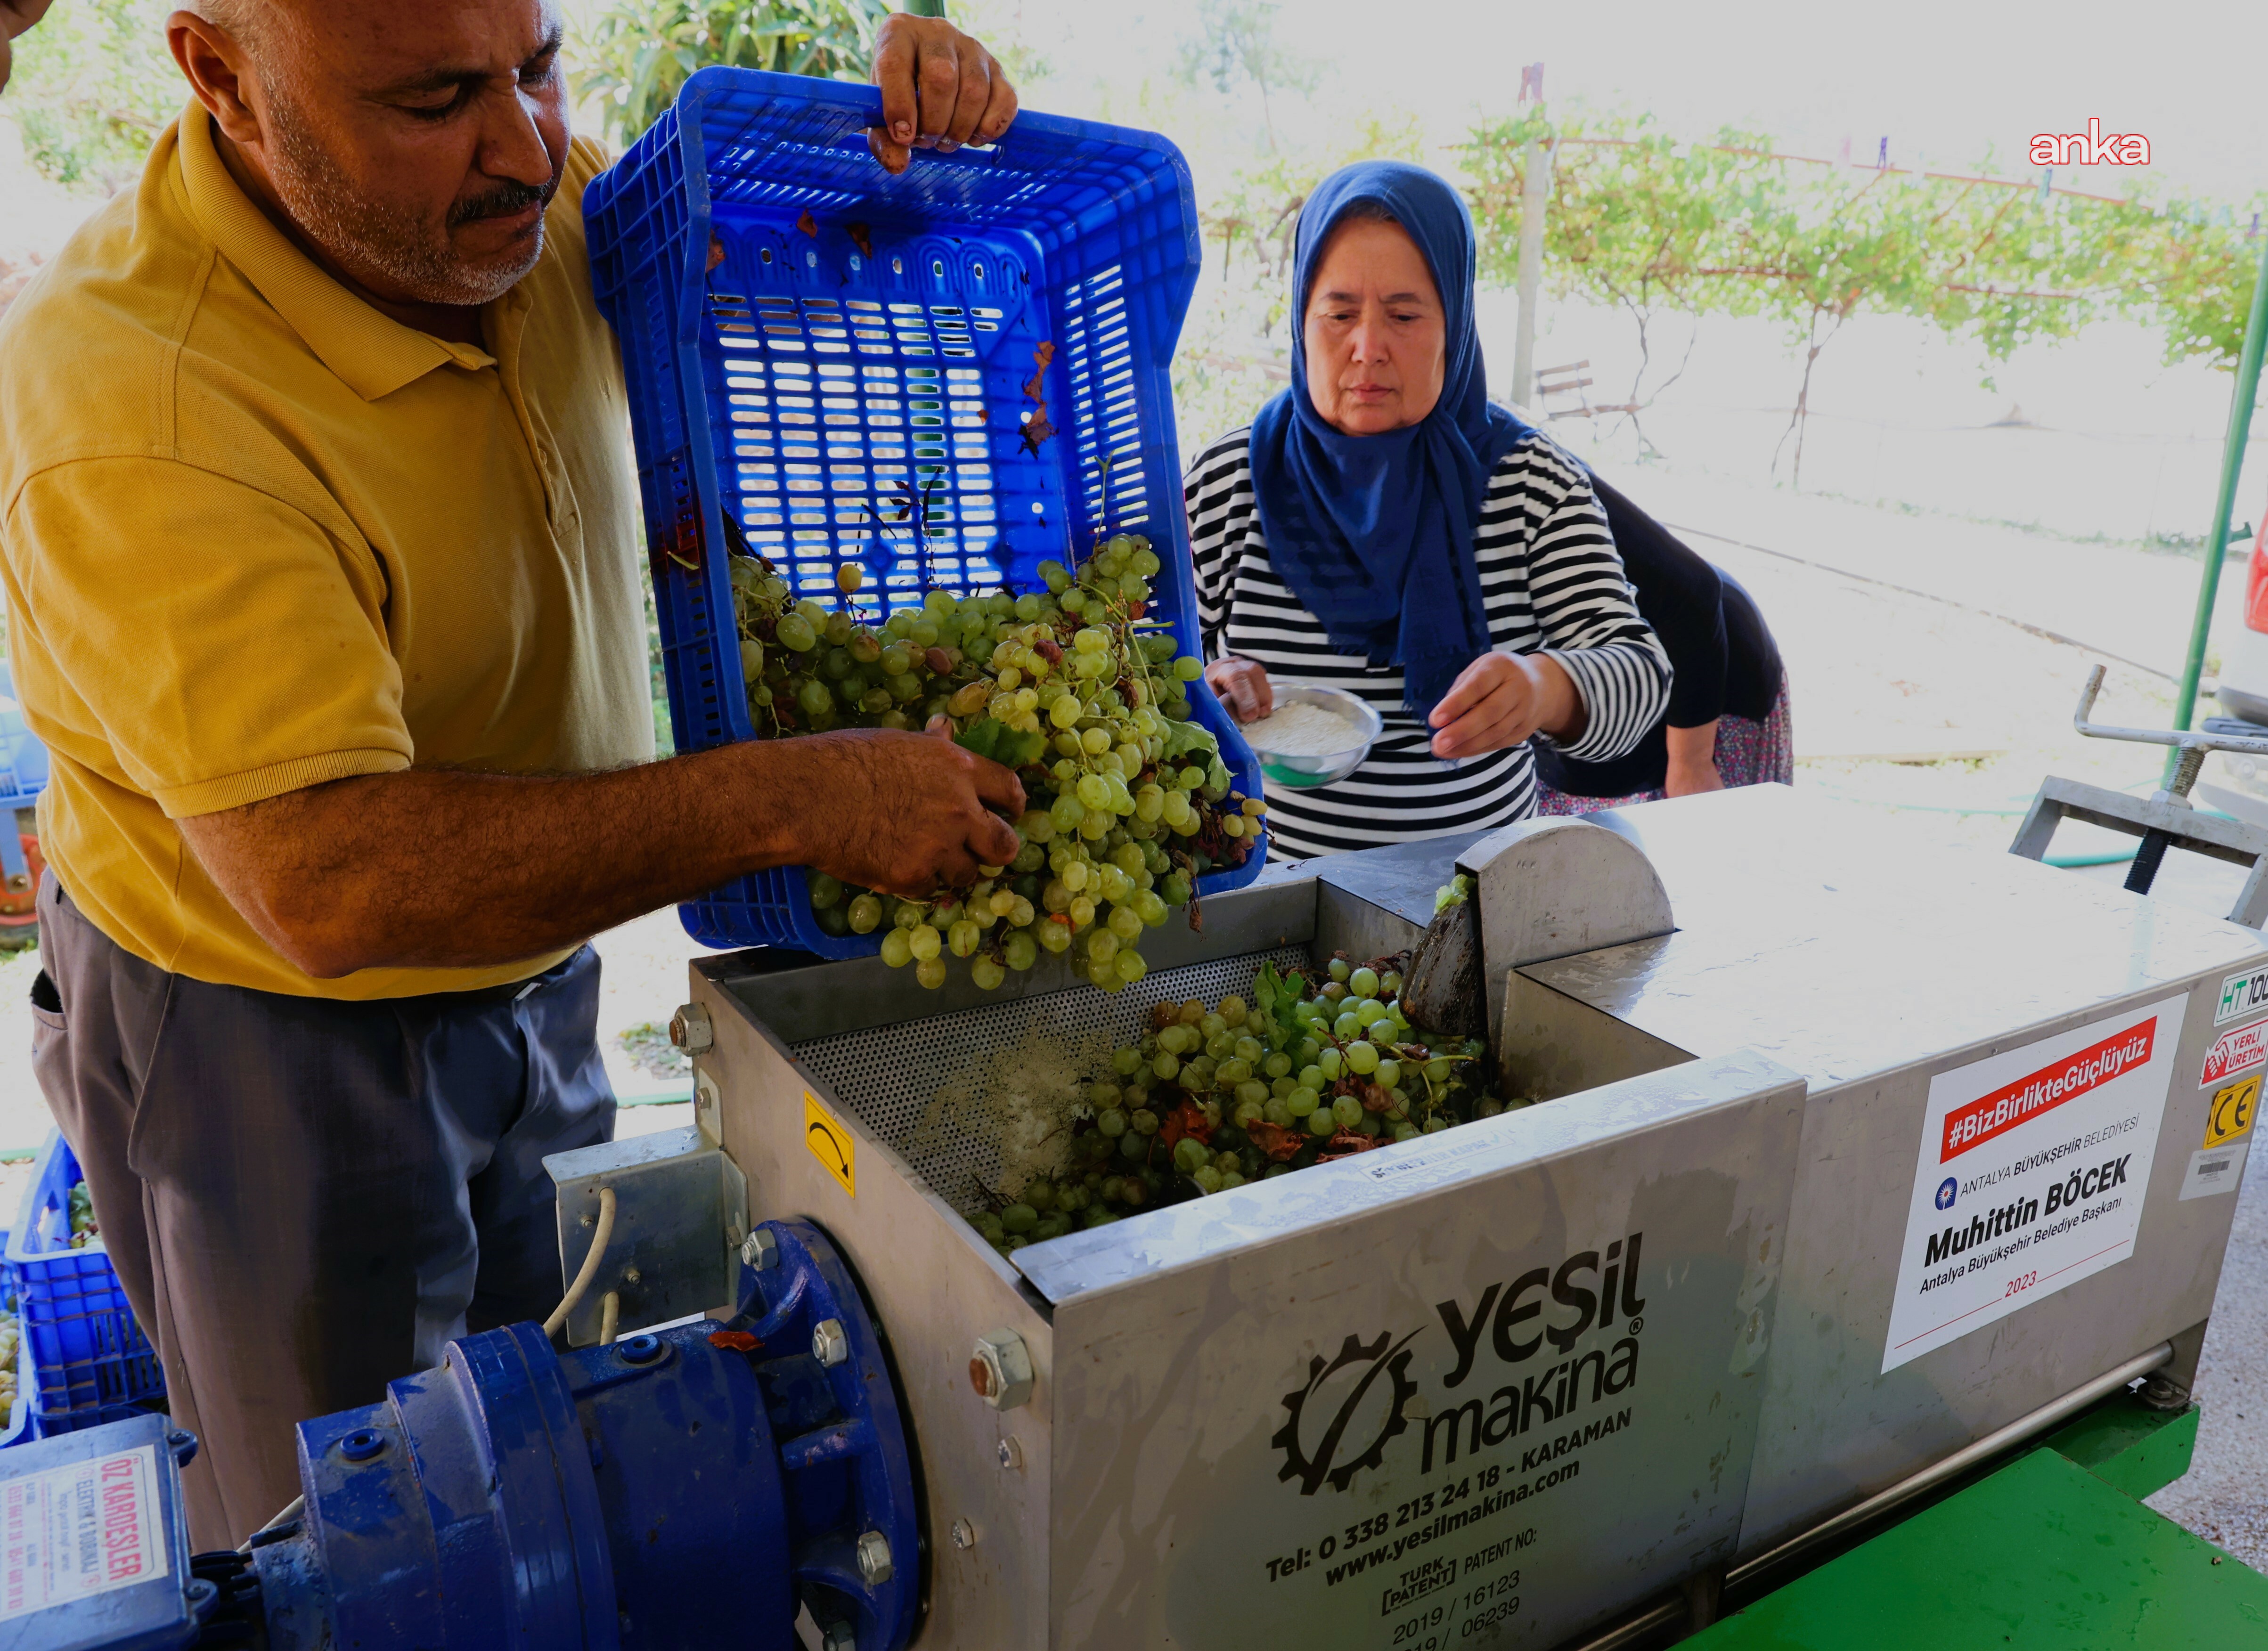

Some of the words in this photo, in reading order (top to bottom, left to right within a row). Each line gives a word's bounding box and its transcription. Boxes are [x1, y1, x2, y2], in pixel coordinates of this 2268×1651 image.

[2219, 979, 2248, 1016] HT
[2228, 1044, 2265, 1068] ÜRETİM
[2234, 1026, 2262, 1051] YERLİ
[1949, 1036, 2147, 1149] #BizBirlikteGüçlüyüz
[1960, 1166, 2011, 1197] ANTALYA
[2014, 1137, 2081, 1176] BÜYÜKŞEHİR
[2083, 1113, 2140, 1148] BELEDİYESİ
[1919, 1265, 1965, 1294] Antalya
[1968, 1235, 2032, 1273] Büyükşehir
[2034, 1215, 2079, 1244] Belediye
[2081, 1197, 2121, 1223] Başkanı
[1924, 1196, 2038, 1268] Muhittin
[2044, 1153, 2132, 1216] BÖCEK
[2005, 1270, 2037, 1298] 2023
[101, 1457, 139, 1482] ÖZ
[1266, 1547, 1312, 1582] Tel:
[1319, 1536, 1336, 1560] 0
[1343, 1513, 1389, 1551] 338
[1395, 1491, 1435, 1528] 213
[1442, 1477, 1470, 1507] 24
[1477, 1464, 1501, 1491] 18
[1506, 1466, 1516, 1474] -
[1521, 1407, 1632, 1473] KARAMAN
[102, 1480, 143, 1582] KARDEŞLER
[1325, 1460, 1580, 1587] www.yesilmakina.com
[1464, 1537, 1513, 1575] PATENT
[1515, 1528, 1537, 1551] NO:
[1393, 1607, 1444, 1645] 2019
[1464, 1570, 1520, 1610] 16123
[1461, 1596, 1520, 1638] 06239
